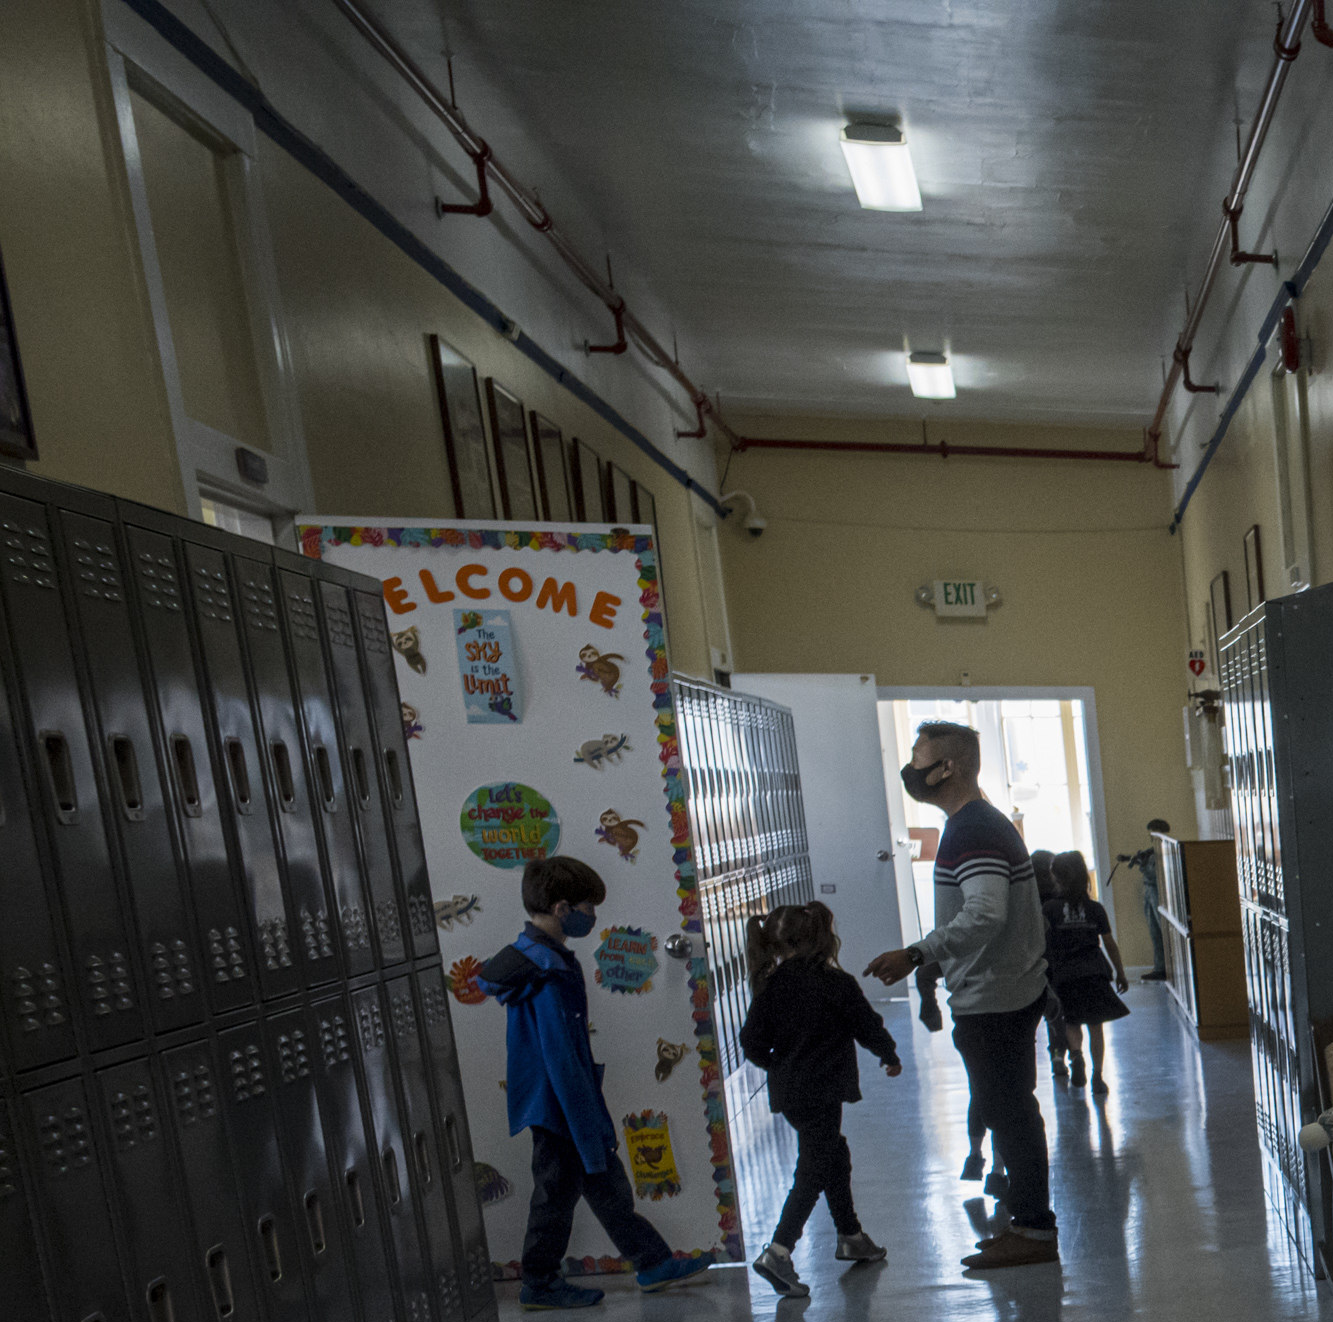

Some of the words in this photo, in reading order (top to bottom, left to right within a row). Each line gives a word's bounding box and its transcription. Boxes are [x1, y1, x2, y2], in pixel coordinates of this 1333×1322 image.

[383, 564, 622, 629] ELCOME
[943, 582, 976, 605] EXIT
[476, 628, 495, 640] The
[483, 664, 500, 676] the
[489, 784, 522, 803] Let's
[468, 804, 526, 824] change
[530, 808, 548, 819] the
[482, 824, 542, 845] world
[608, 937, 648, 955] LEARN
